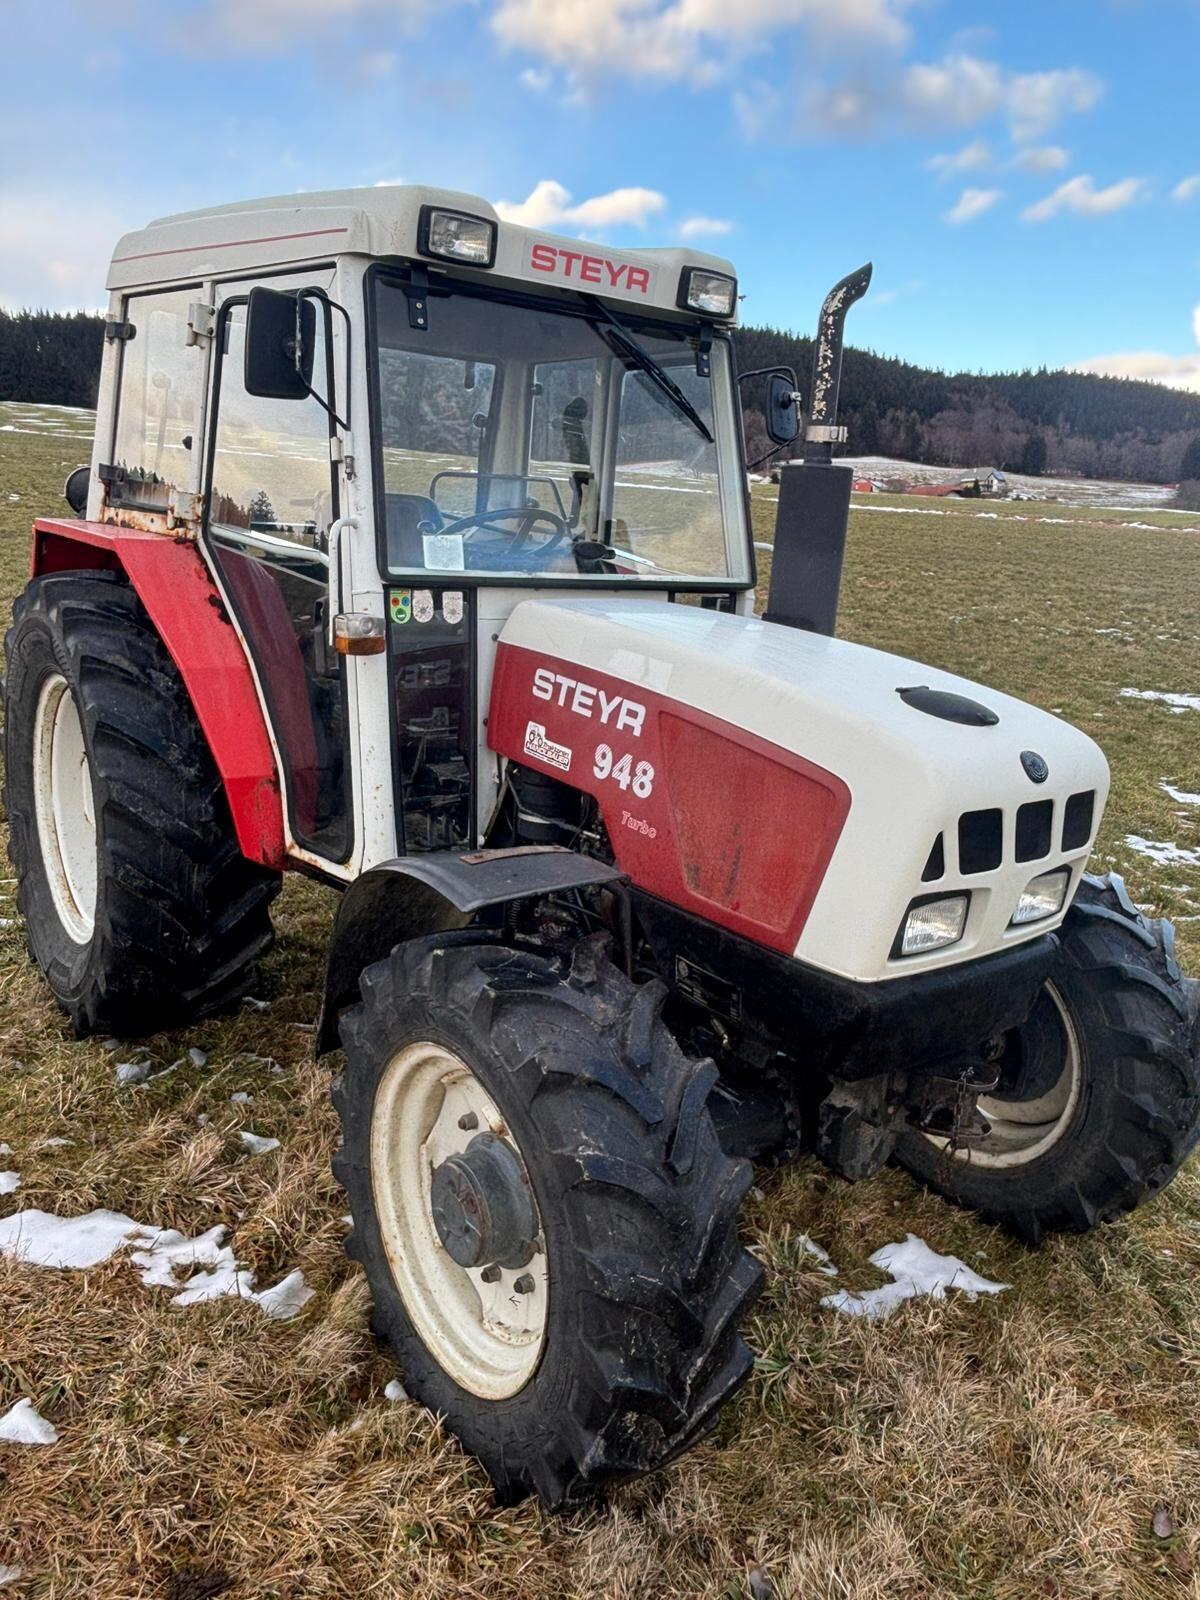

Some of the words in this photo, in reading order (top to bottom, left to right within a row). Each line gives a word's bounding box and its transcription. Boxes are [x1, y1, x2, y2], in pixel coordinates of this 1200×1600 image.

[531, 244, 650, 293] STEYR
[532, 668, 647, 737] STEYR
[593, 743, 655, 799] 948
[621, 810, 657, 839] Turbo
